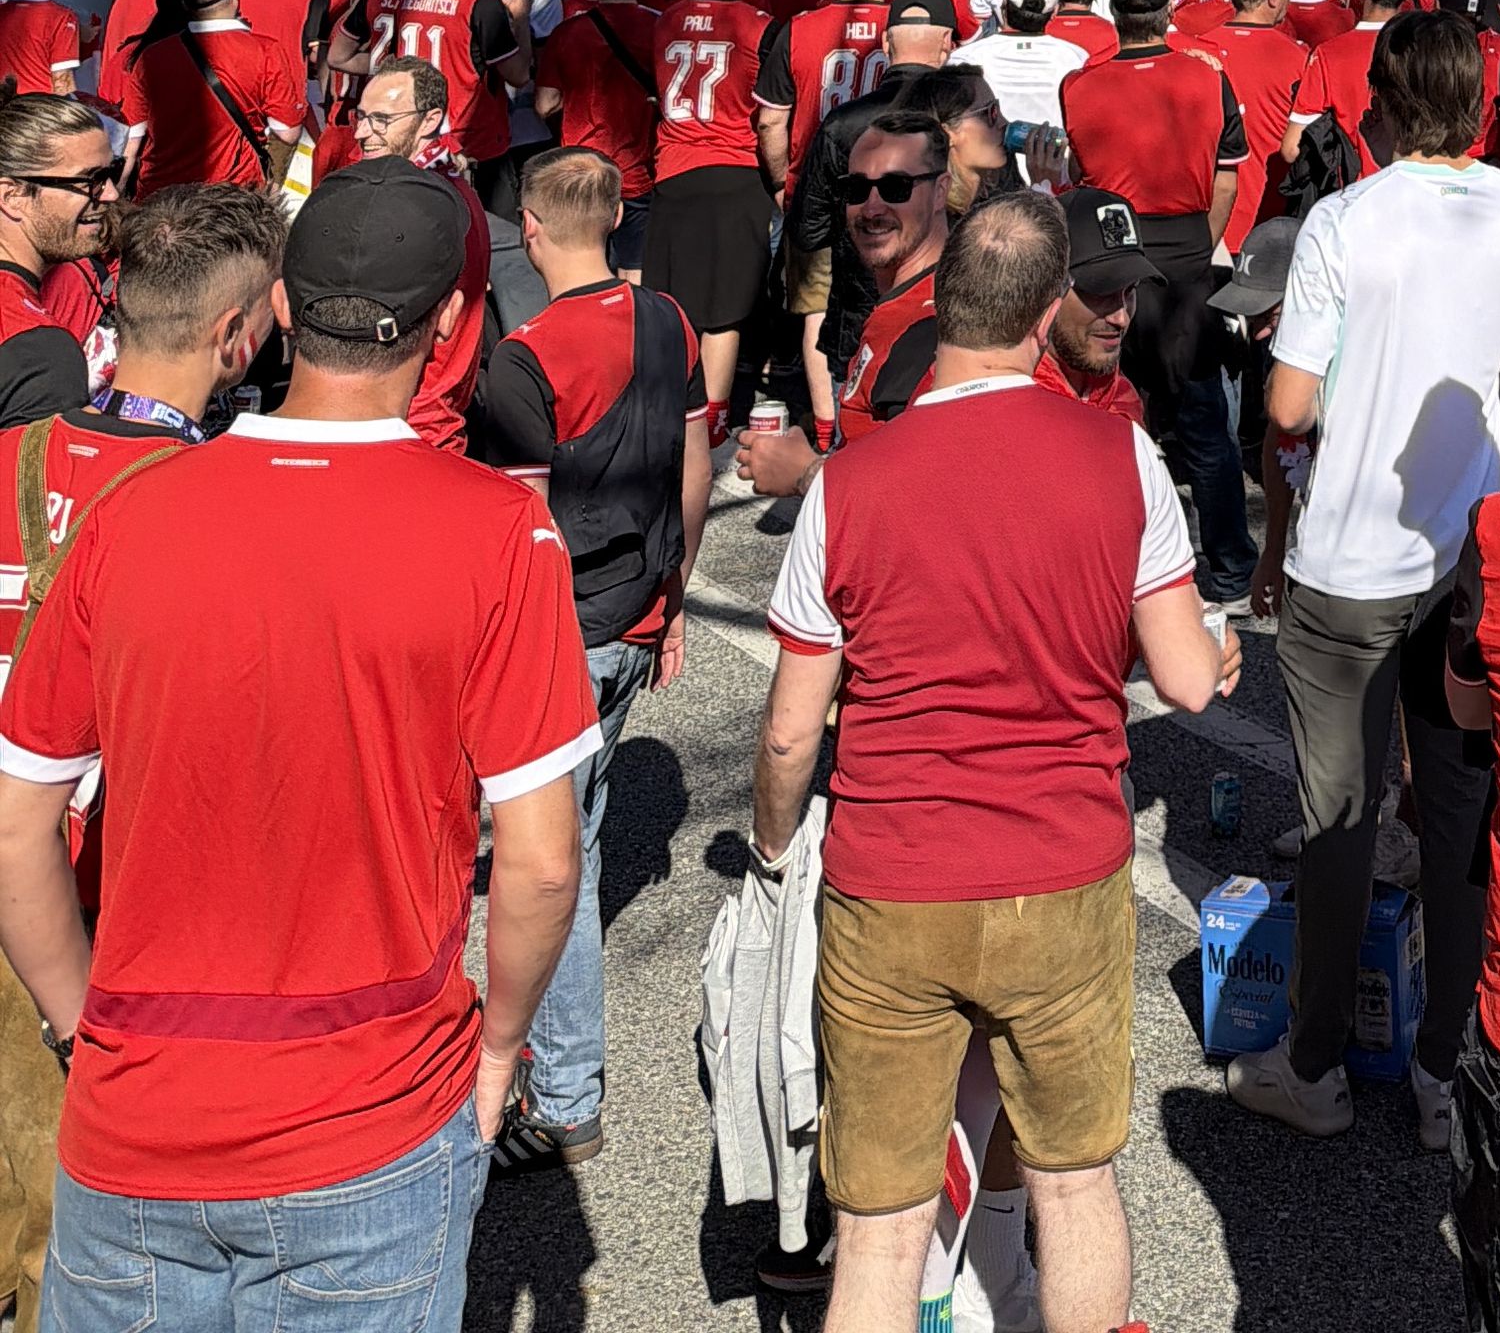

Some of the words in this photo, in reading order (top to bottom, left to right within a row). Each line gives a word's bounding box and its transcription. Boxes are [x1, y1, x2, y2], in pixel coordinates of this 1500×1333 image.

[683, 15, 714, 32] PAUL
[400, 22, 445, 72] 11
[665, 40, 735, 123] 27
[1206, 914, 1226, 930] 24
[1208, 943, 1285, 985] Modelo
